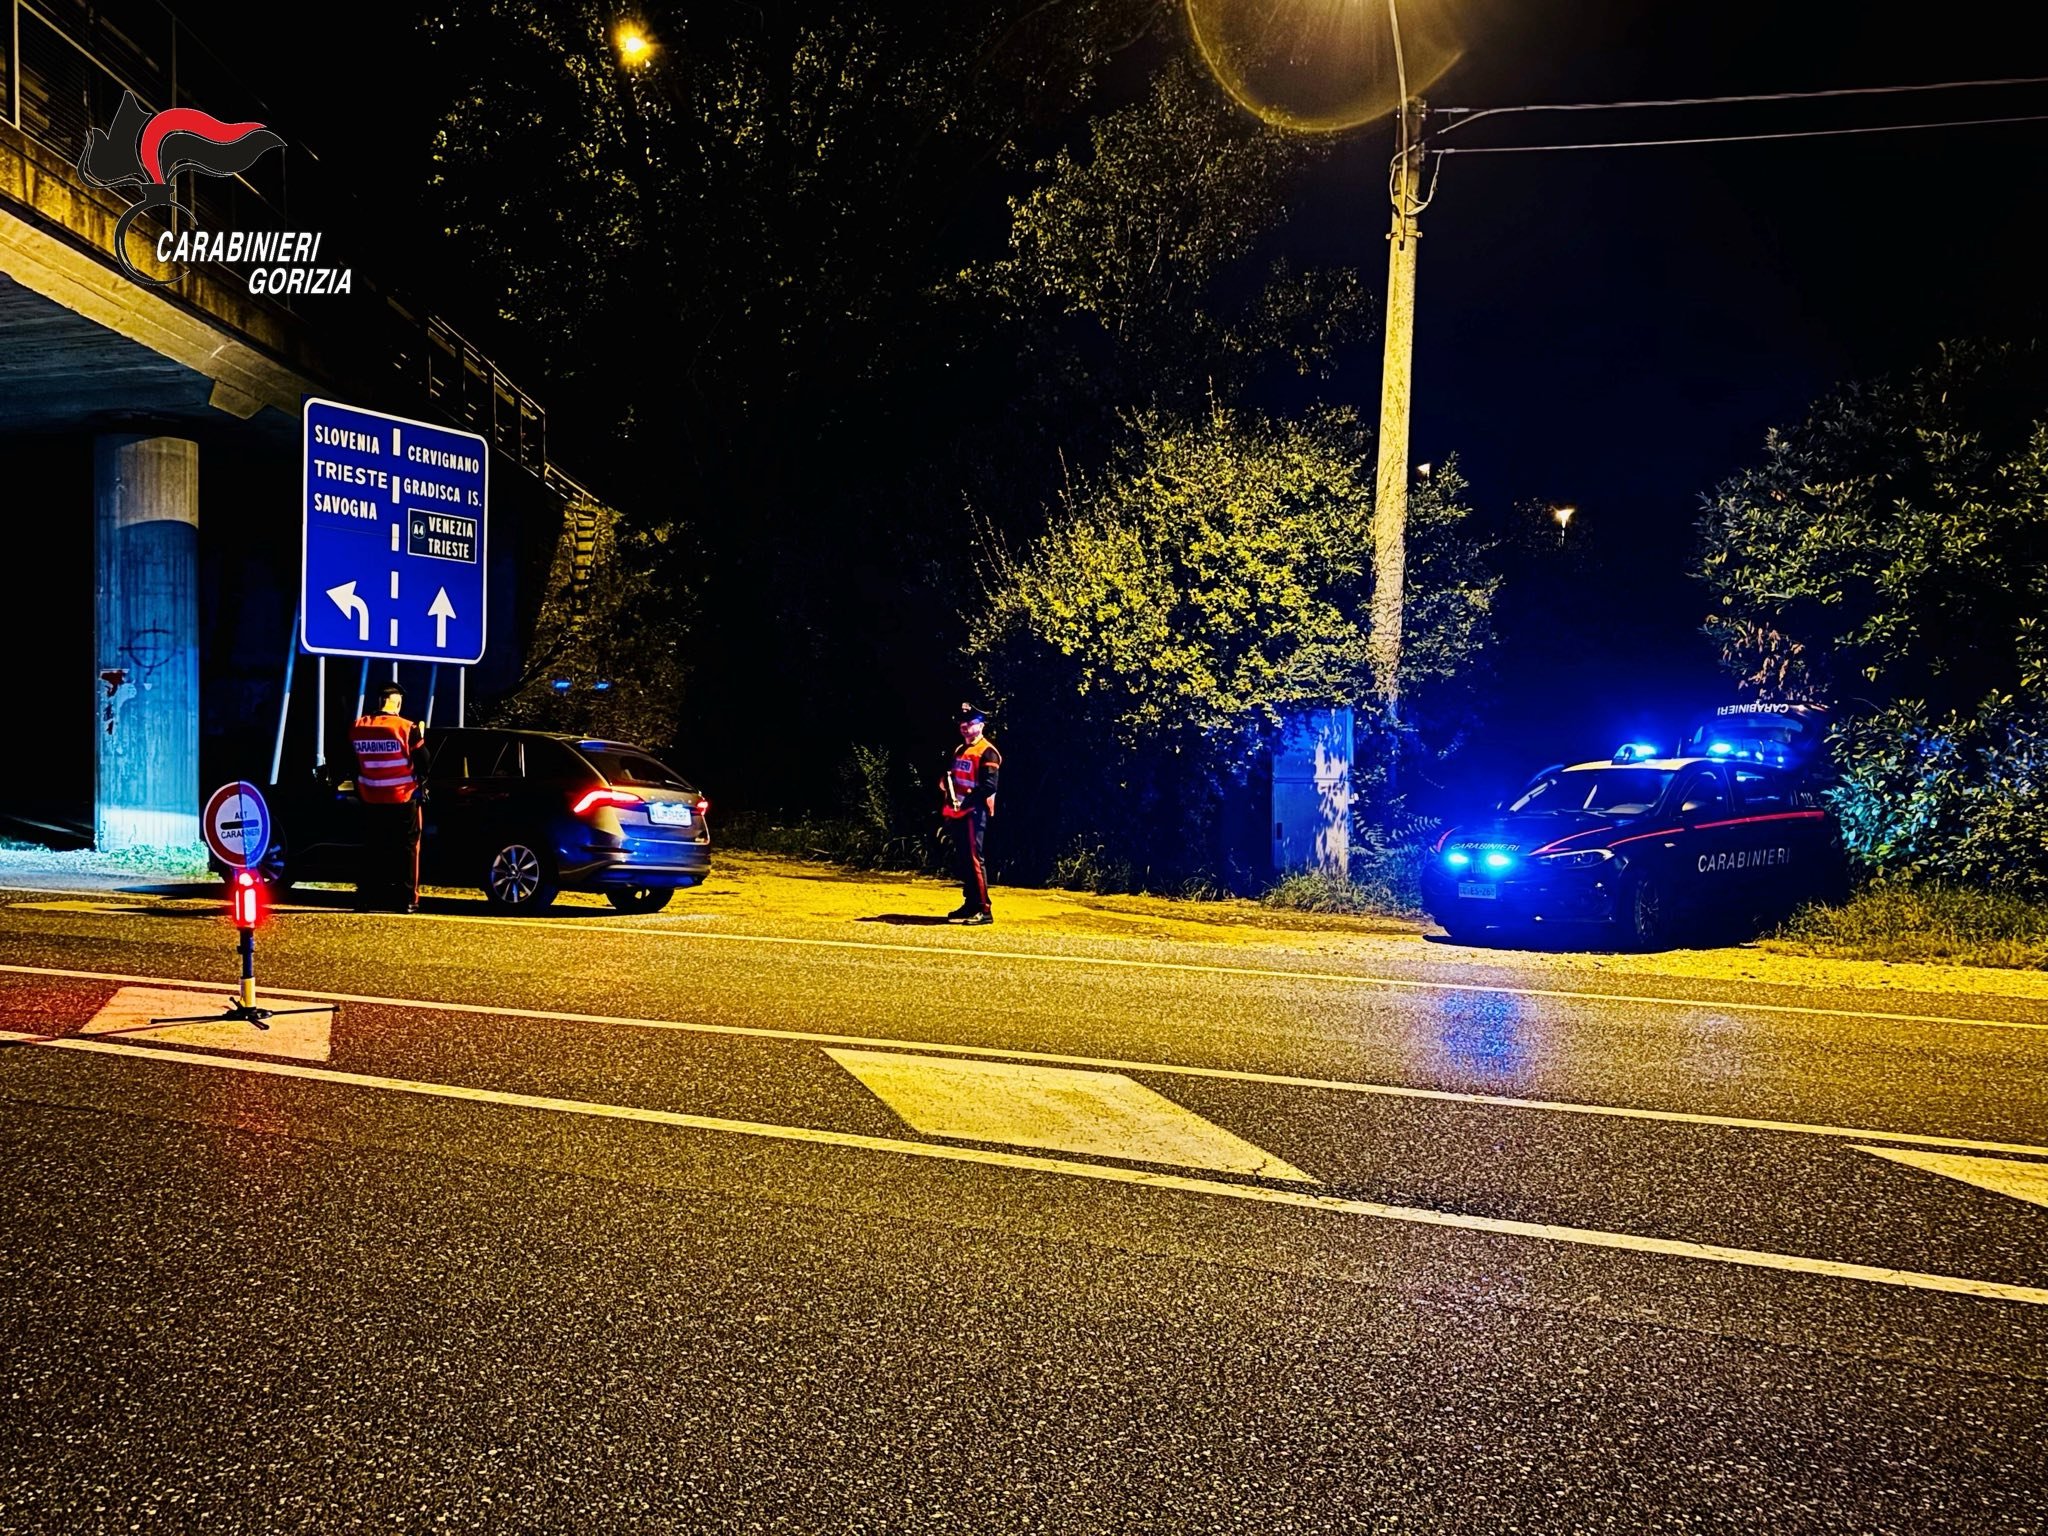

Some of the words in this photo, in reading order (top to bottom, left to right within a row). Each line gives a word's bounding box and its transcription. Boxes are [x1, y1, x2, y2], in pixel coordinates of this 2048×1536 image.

[314, 424, 380, 455] SLOVENIA
[407, 445, 479, 474] CERVIGNANO
[314, 459, 388, 489] TRIESTE
[403, 477, 461, 503] GRADISCA
[468, 490, 482, 507] IS.
[314, 492, 378, 520] SAVOGNA
[413, 523, 424, 535] A4
[428, 516, 474, 538] VENEZIA
[428, 537, 469, 559] TRIESTE
[1717, 703, 1789, 716] CARABINIERI
[354, 740, 400, 753] CARABINIERI
[1451, 842, 1520, 851] CARABINIERI
[1698, 847, 1790, 873] CARABINIERI
